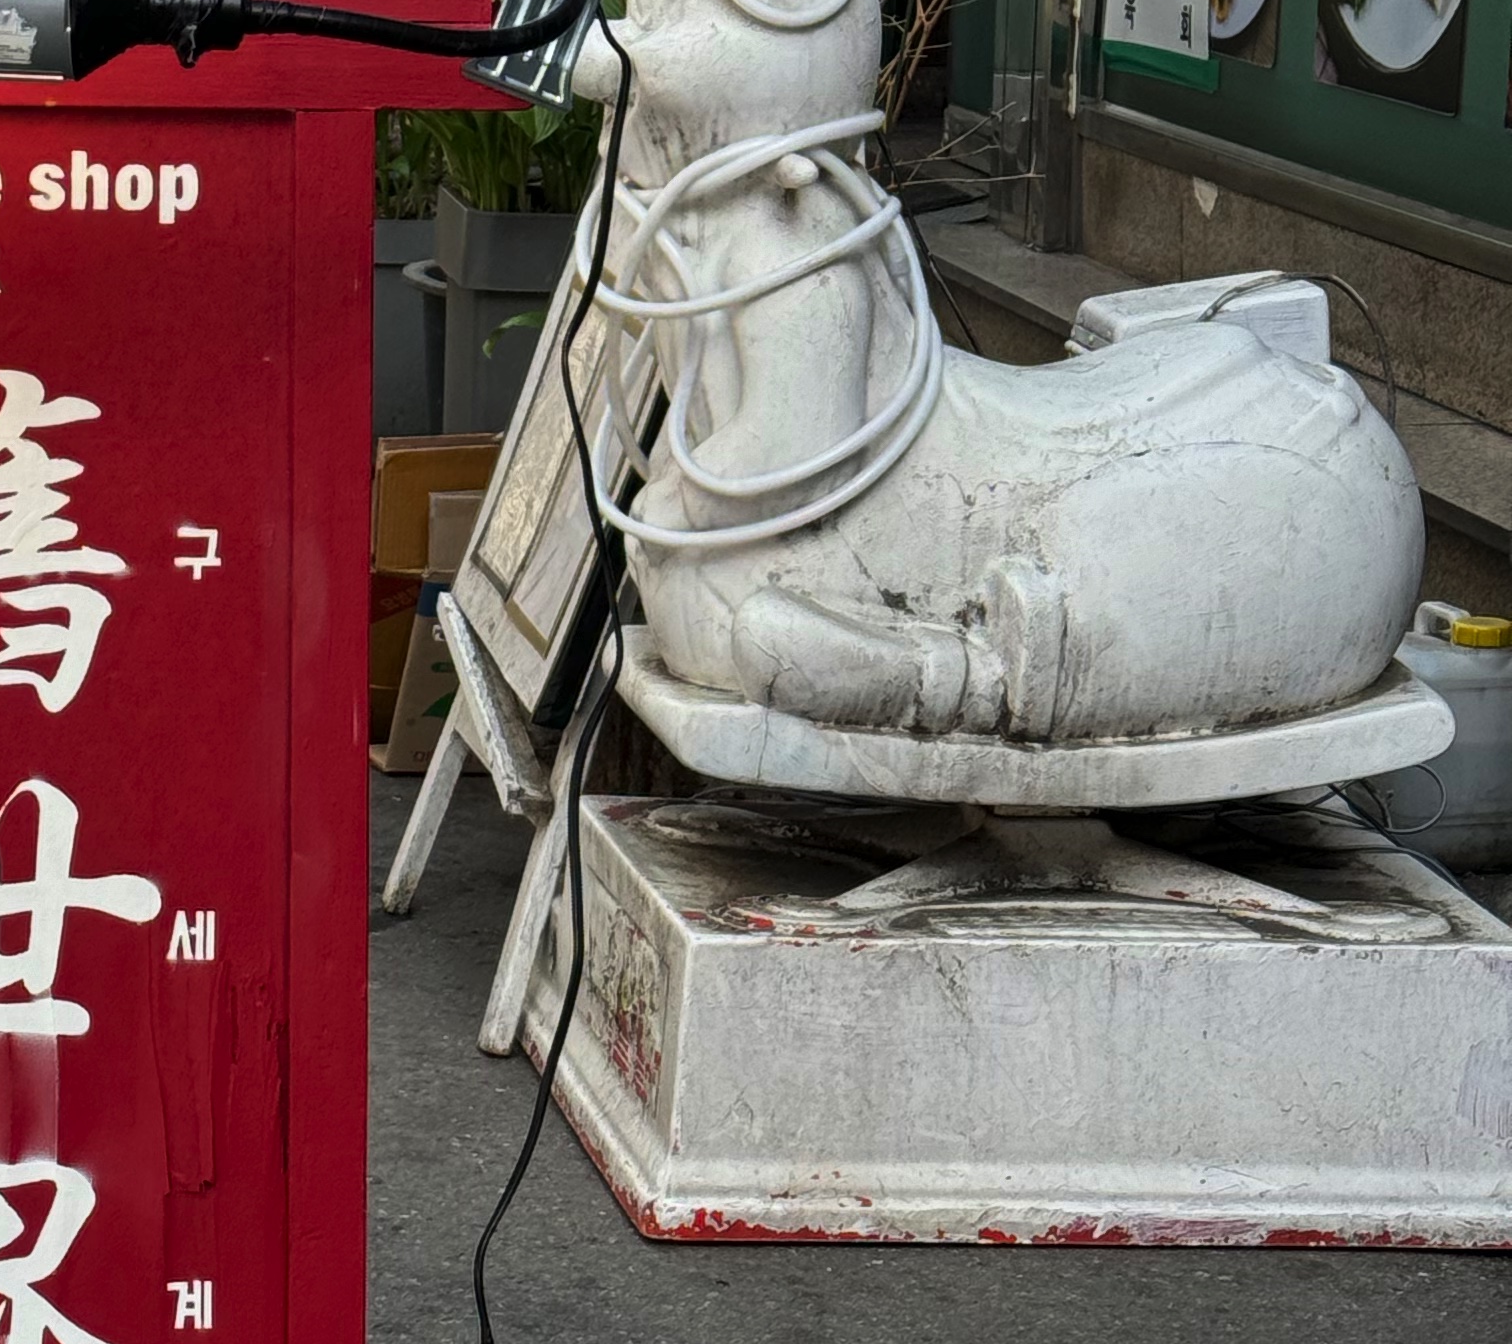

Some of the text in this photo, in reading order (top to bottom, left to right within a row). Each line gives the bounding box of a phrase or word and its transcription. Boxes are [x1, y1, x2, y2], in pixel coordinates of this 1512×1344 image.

[29, 150, 199, 224] shop
[174, 525, 222, 581] 구
[167, 910, 216, 963] 세
[166, 1279, 213, 1330] 계
